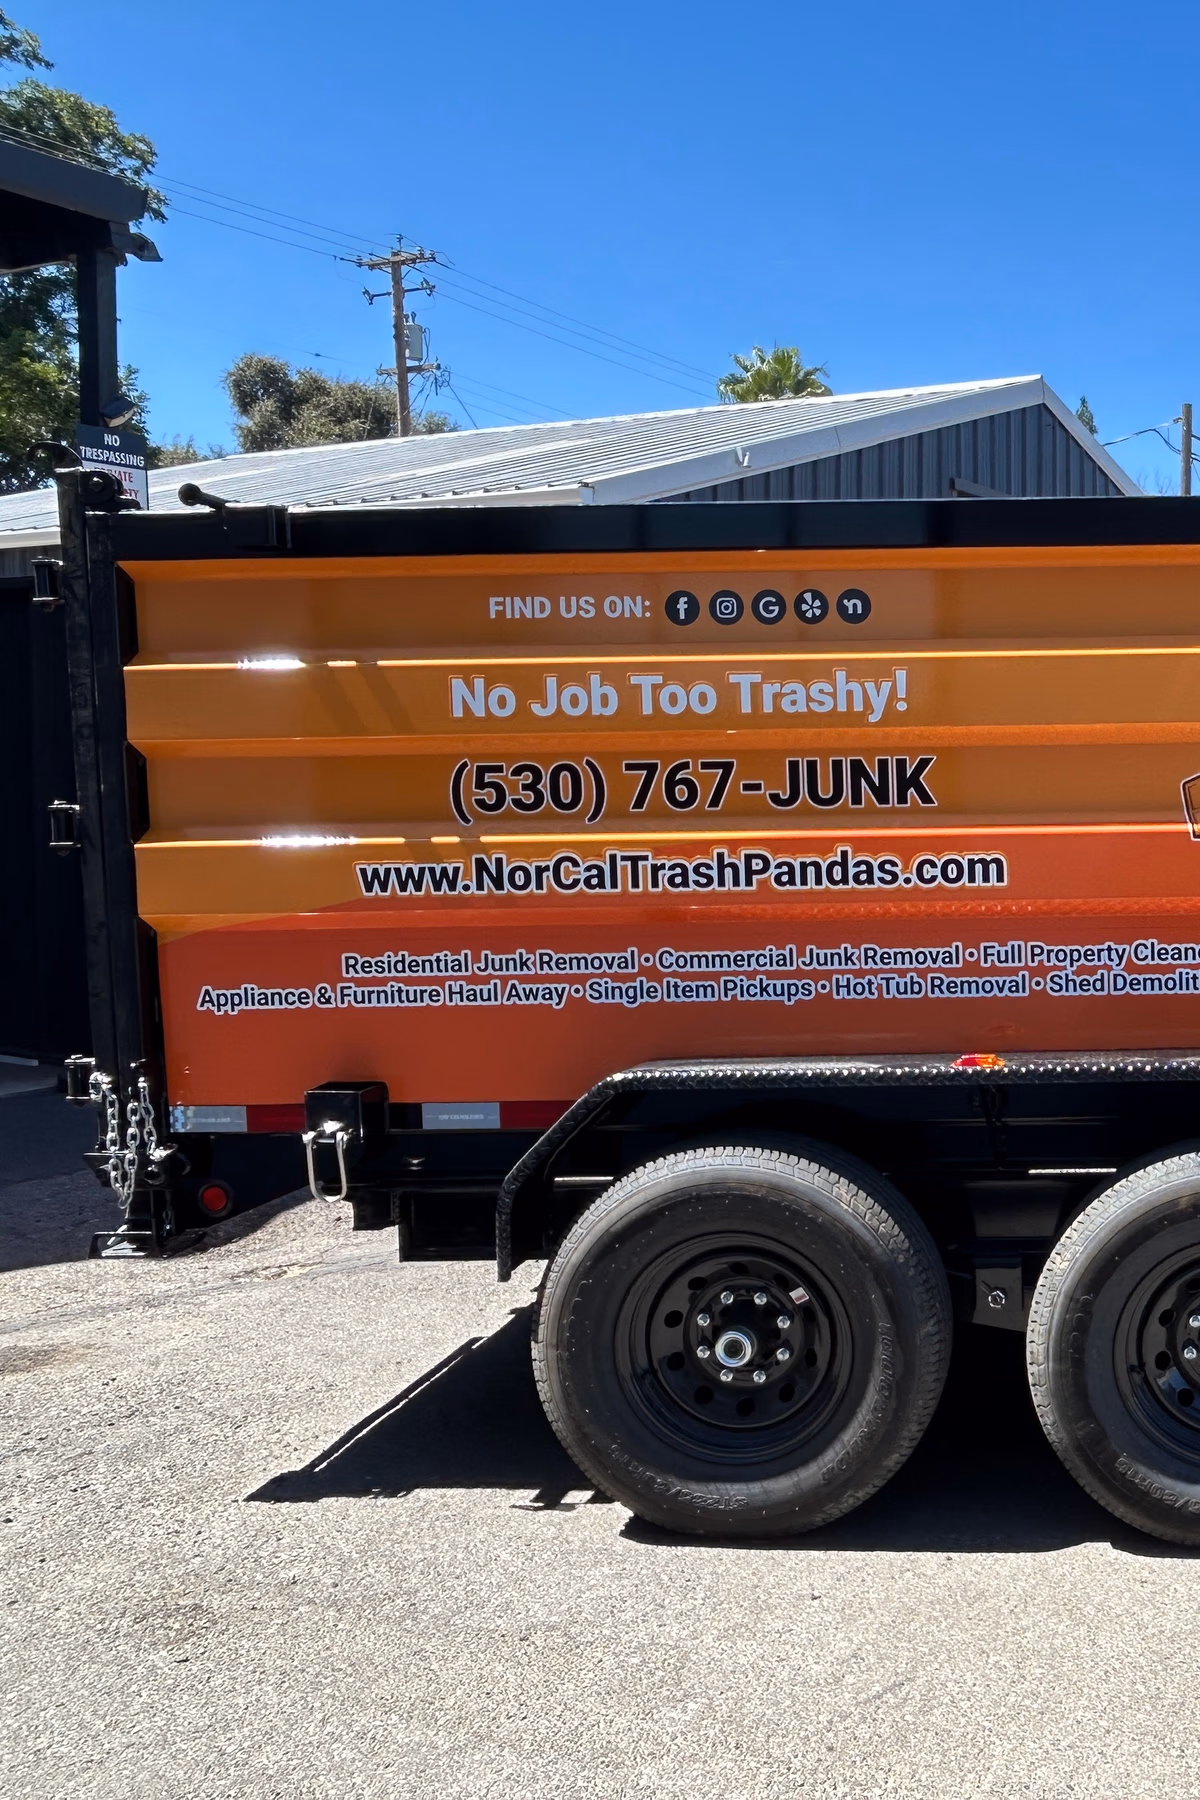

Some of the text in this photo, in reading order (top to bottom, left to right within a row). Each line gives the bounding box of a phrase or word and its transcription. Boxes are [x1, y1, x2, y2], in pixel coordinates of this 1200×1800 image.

[80, 446, 144, 467] TRESPASSING
[103, 433, 120, 447] NO
[489, 597, 550, 619] FIND
[560, 596, 595, 619] US
[604, 595, 651, 618] ON:
[449, 668, 909, 722] No Job Too Trashy!
[449, 755, 937, 825] (530) 767-JUNK
[356, 846, 1007, 896] www.NorCalTrashPandas.com
[342, 951, 472, 978] Residential
[475, 950, 534, 976] Junk
[537, 947, 638, 974] Removal
[656, 944, 796, 972] Commercial
[799, 944, 859, 970] Junk
[862, 942, 962, 968] Removal
[980, 941, 1024, 967] Full
[1028, 940, 1129, 969] Property
[197, 985, 310, 1015] Appliance
[314, 985, 335, 1007] &
[338, 984, 441, 1009] Furniture
[446, 982, 500, 1007] Haul
[504, 982, 568, 1009] Away
[586, 979, 659, 1008] Single
[664, 977, 716, 1002] Item
[721, 975, 815, 1006] Pickups
[833, 975, 879, 999] Hot
[880, 974, 924, 998] Tub
[928, 972, 1029, 997] Removal
[1047, 970, 1105, 995] Shed
